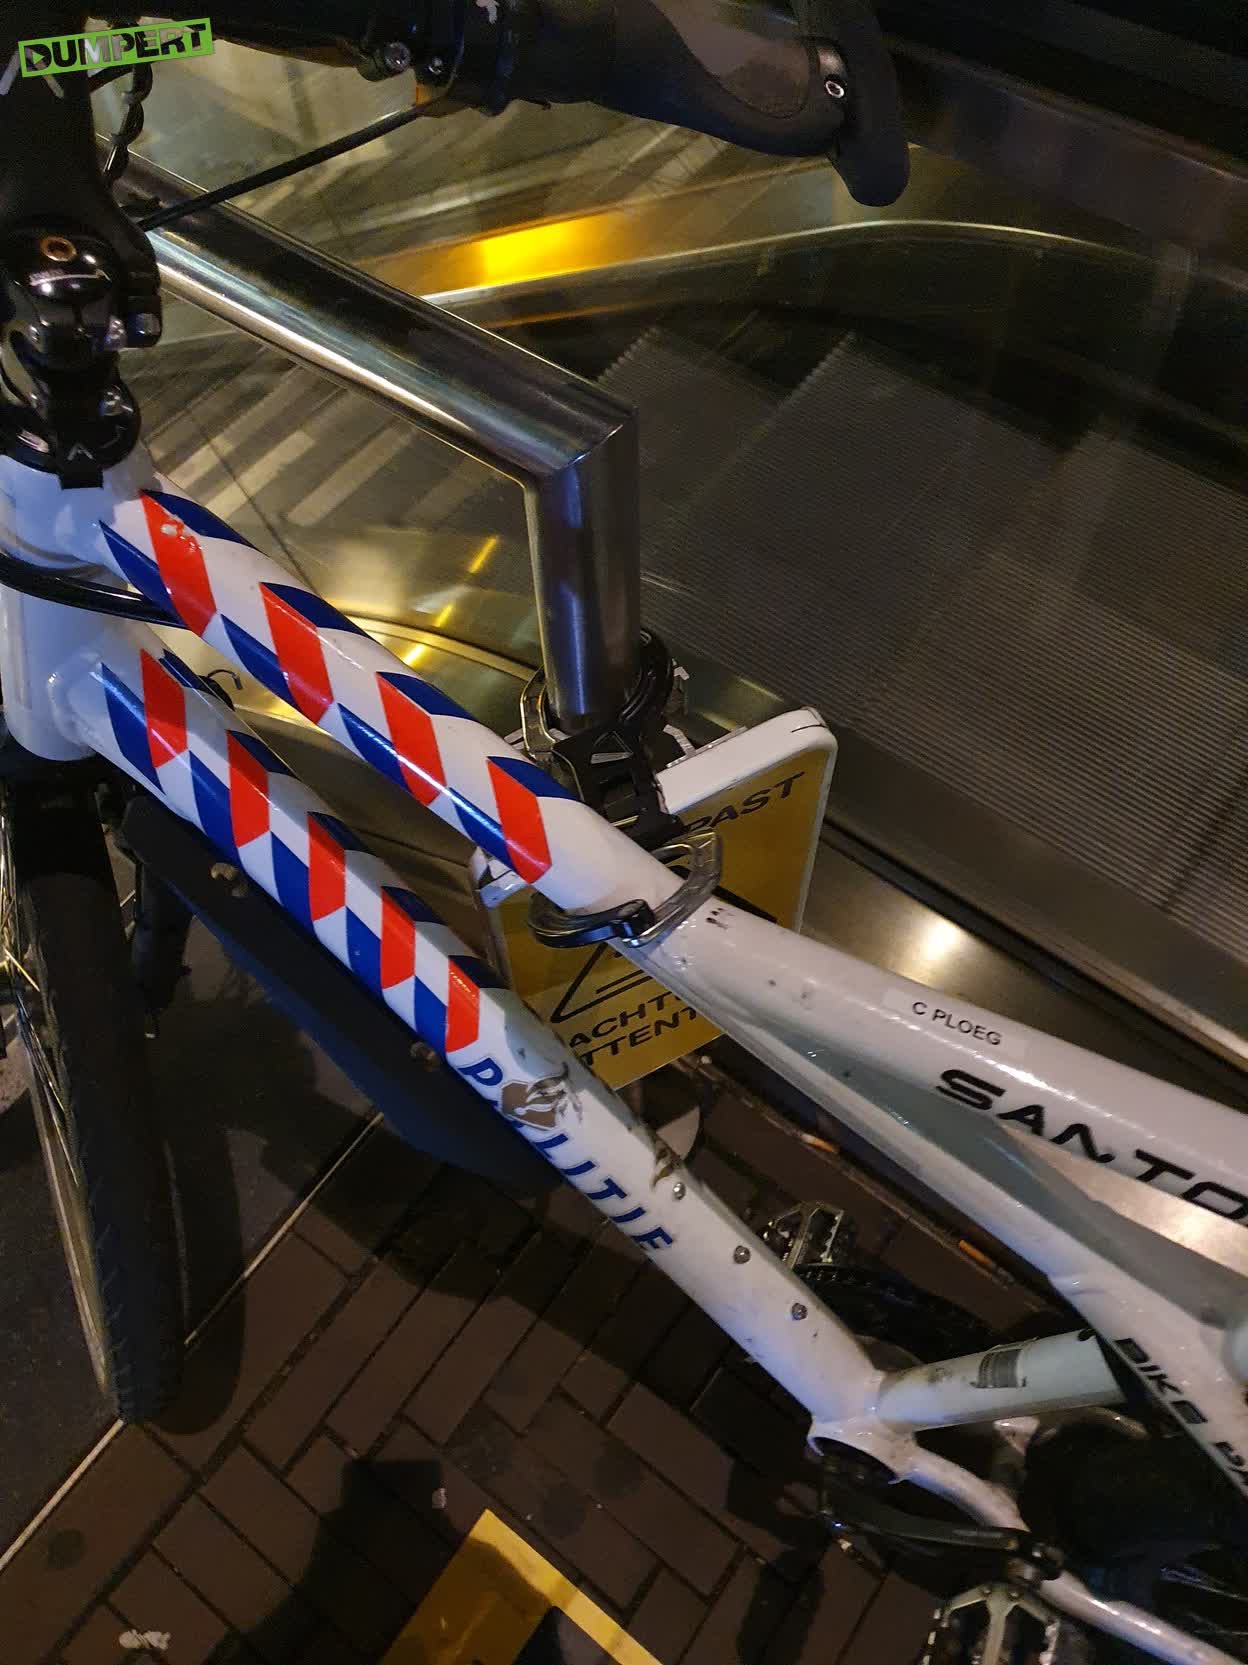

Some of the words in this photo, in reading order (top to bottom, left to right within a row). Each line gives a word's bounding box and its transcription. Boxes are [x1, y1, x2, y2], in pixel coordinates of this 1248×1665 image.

[682, 771, 806, 833] PAST
[569, 990, 683, 1048] ACHT
[578, 1006, 697, 1066] TTENT
[911, 1001, 928, 1016] C
[931, 1008, 1003, 1046] PLOEG
[457, 1056, 675, 1250] PLITIE
